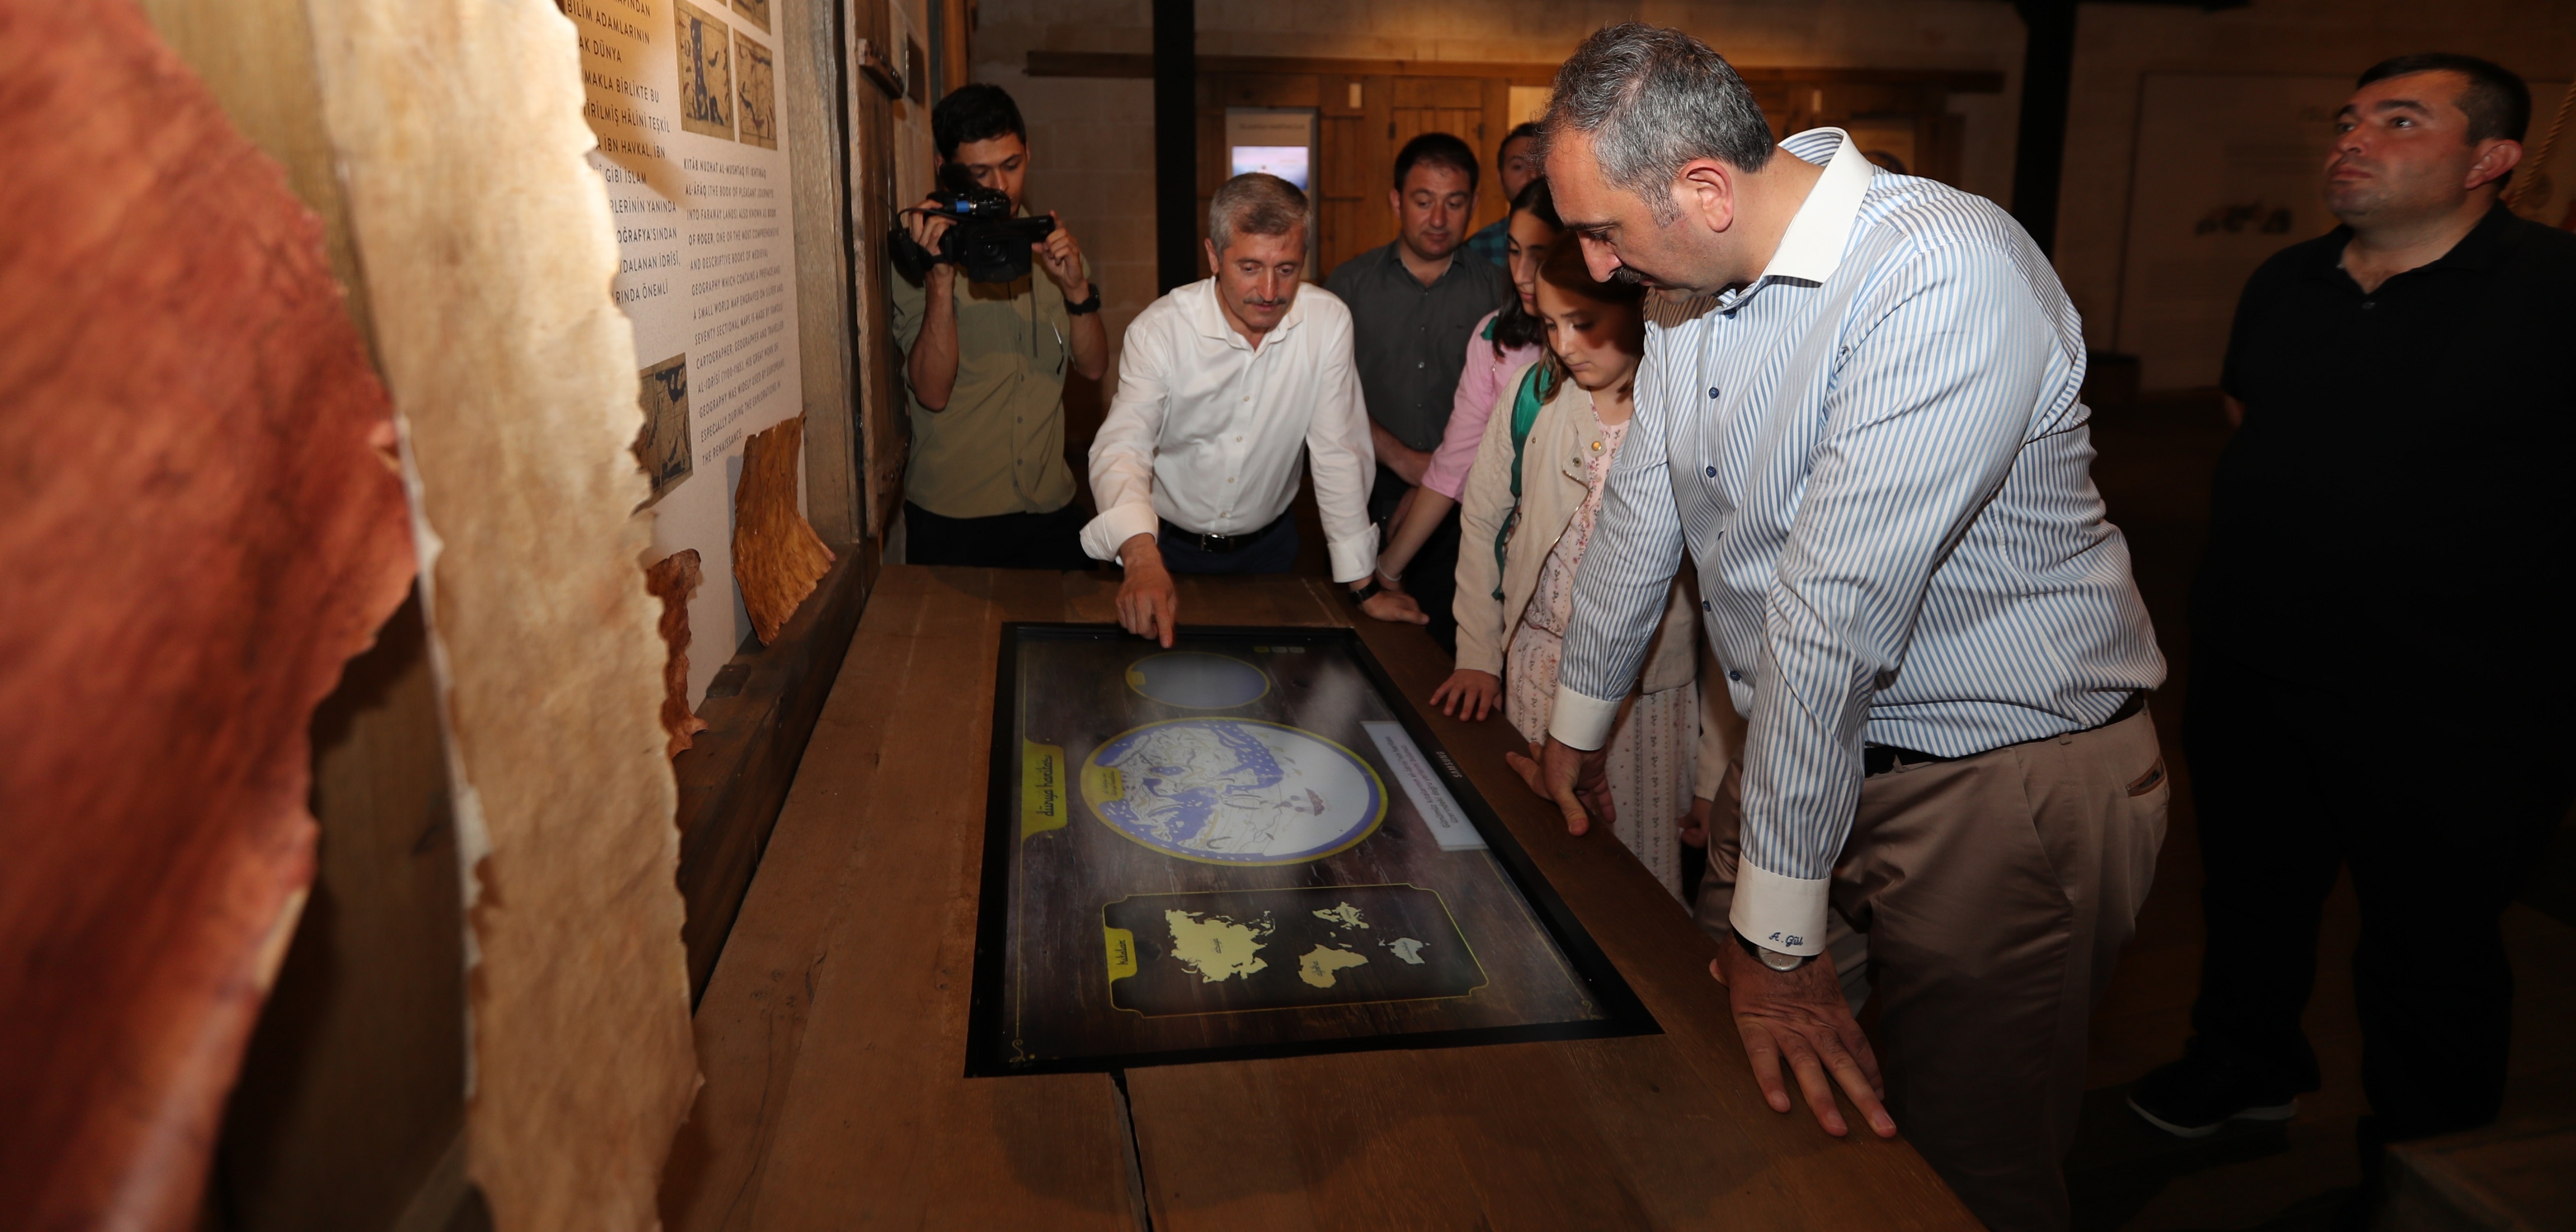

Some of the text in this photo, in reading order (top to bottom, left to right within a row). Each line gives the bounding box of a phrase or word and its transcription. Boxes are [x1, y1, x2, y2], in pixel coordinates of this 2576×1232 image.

[615, 0, 650, 18] INDAN
[596, 10, 650, 44] ADAMLARININ
[593, 38, 621, 63] DÜNYA
[585, 69, 659, 103] MAKLA BİRLİKTE BU
[649, 116, 670, 134] TEŞKİL
[604, 133, 618, 152] İBN
[621, 139, 652, 160] HAVKAL,
[653, 141, 665, 159] İBN
[606, 165, 622, 183] GİBİ
[625, 166, 646, 184] İSLAM
[708, 185, 718, 196] (THE
[720, 186, 731, 197] BOOK
[732, 186, 737, 197] OF
[647, 200, 676, 213] YANINDA
[687, 209, 699, 220] INTO
[701, 209, 721, 220] FARAWAY
[617, 227, 677, 244] OĞRAFYA'SINDAN
[689, 234, 695, 245] OF
[697, 233, 715, 245] ROGER,
[716, 232, 725, 243] ONE
[727, 231, 732, 242] OF
[617, 256, 657, 275] YDALANAN
[690, 258, 700, 271] AND
[702, 254, 731, 269] DESCRIPTIVE
[732, 251, 745, 264] BOOKS
[642, 279, 668, 299] ÖNEMLİ
[692, 279, 720, 296] GEOGRAPHY
[722, 276, 735, 287] WHICH
[694, 310, 697, 321] A
[698, 305, 713, 319] SMALL
[714, 300, 730, 312] WORLD
[731, 296, 739, 309] MAP
[695, 327, 716, 345] SEVENTY
[717, 319, 739, 336] SECTIONAL
[699, 393, 727, 418] GEOGRAPHY
[729, 386, 737, 399] WAS
[701, 415, 727, 442] ESPECIALLY
[728, 404, 744, 424] DURING
[702, 427, 742, 466] THE RENAISSANCE
[1436, 751, 1462, 778] SAMSUNG
